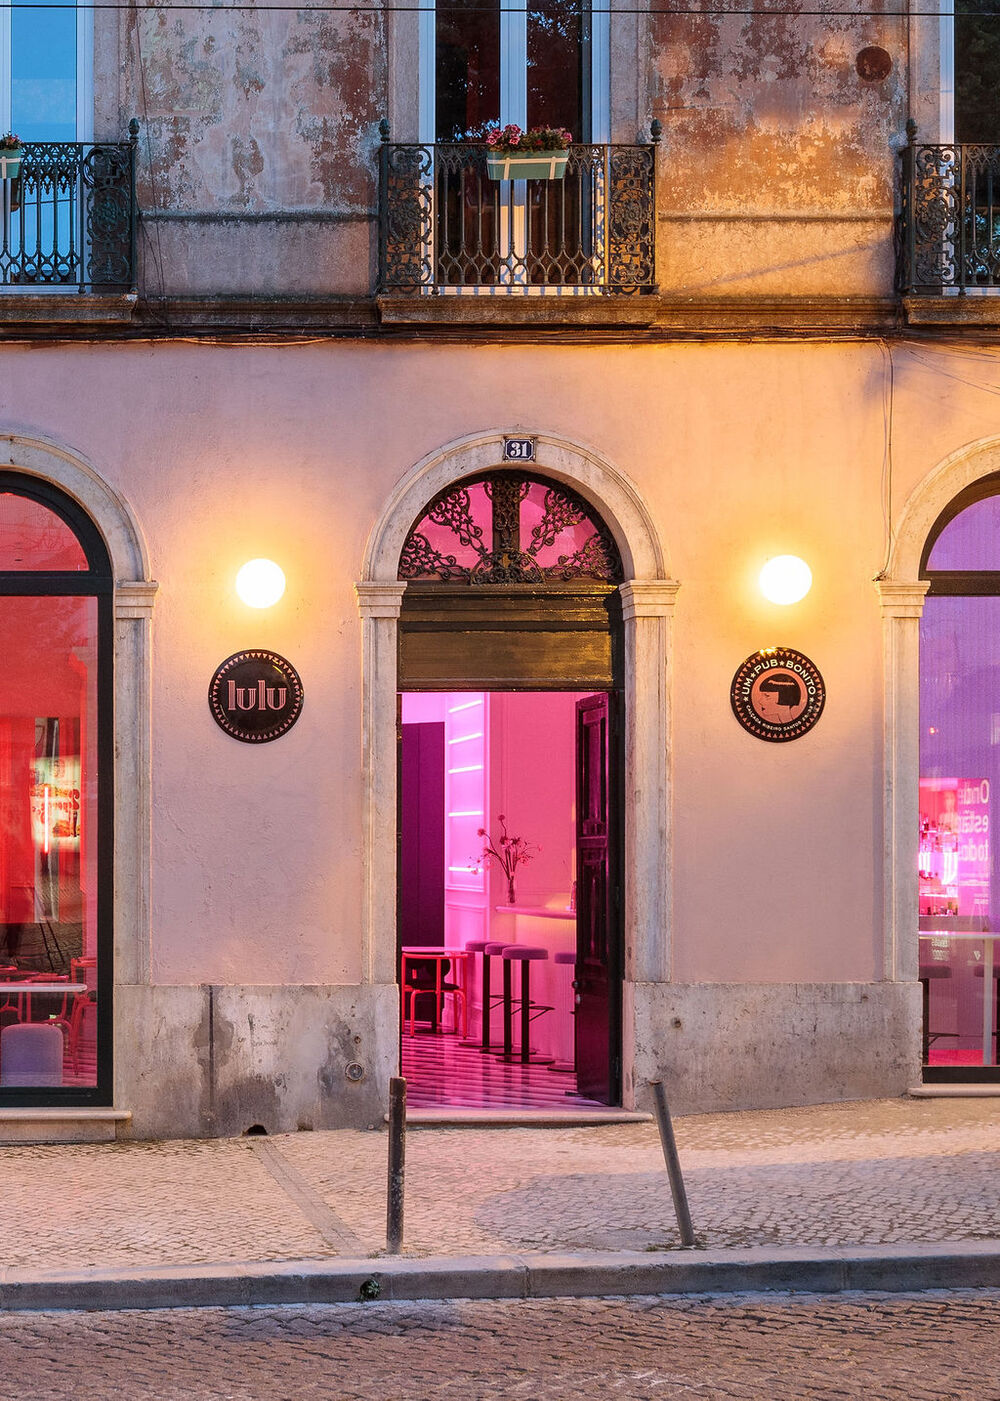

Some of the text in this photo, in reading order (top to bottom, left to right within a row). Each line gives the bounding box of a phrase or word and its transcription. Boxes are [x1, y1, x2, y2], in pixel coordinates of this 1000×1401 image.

[510, 442, 529, 458] 31
[741, 659, 817, 695] UM PUB BONITO
[227, 679, 288, 711] lulu
